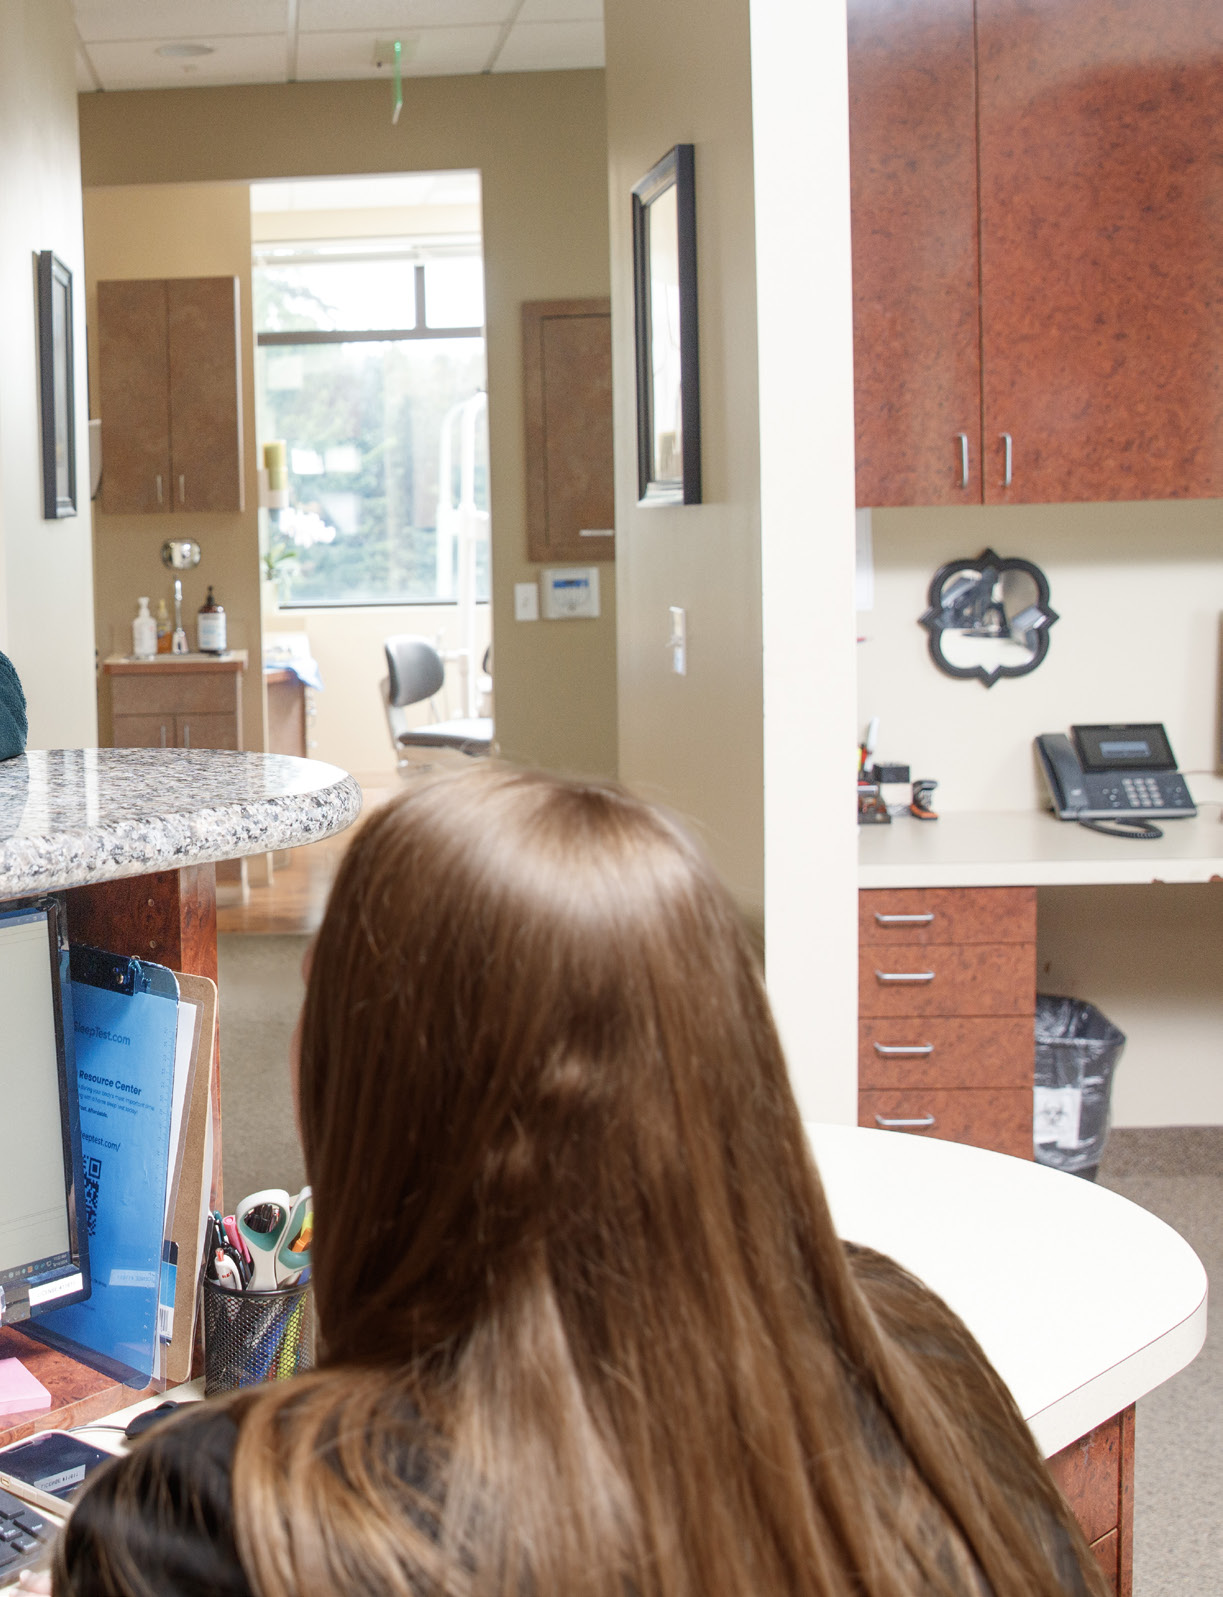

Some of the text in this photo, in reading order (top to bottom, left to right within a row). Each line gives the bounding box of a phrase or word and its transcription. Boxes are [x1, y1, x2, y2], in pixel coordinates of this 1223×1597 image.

[79, 1069, 142, 1096] Resource Center
[80, 1132, 122, 1152] eeptest.com/
